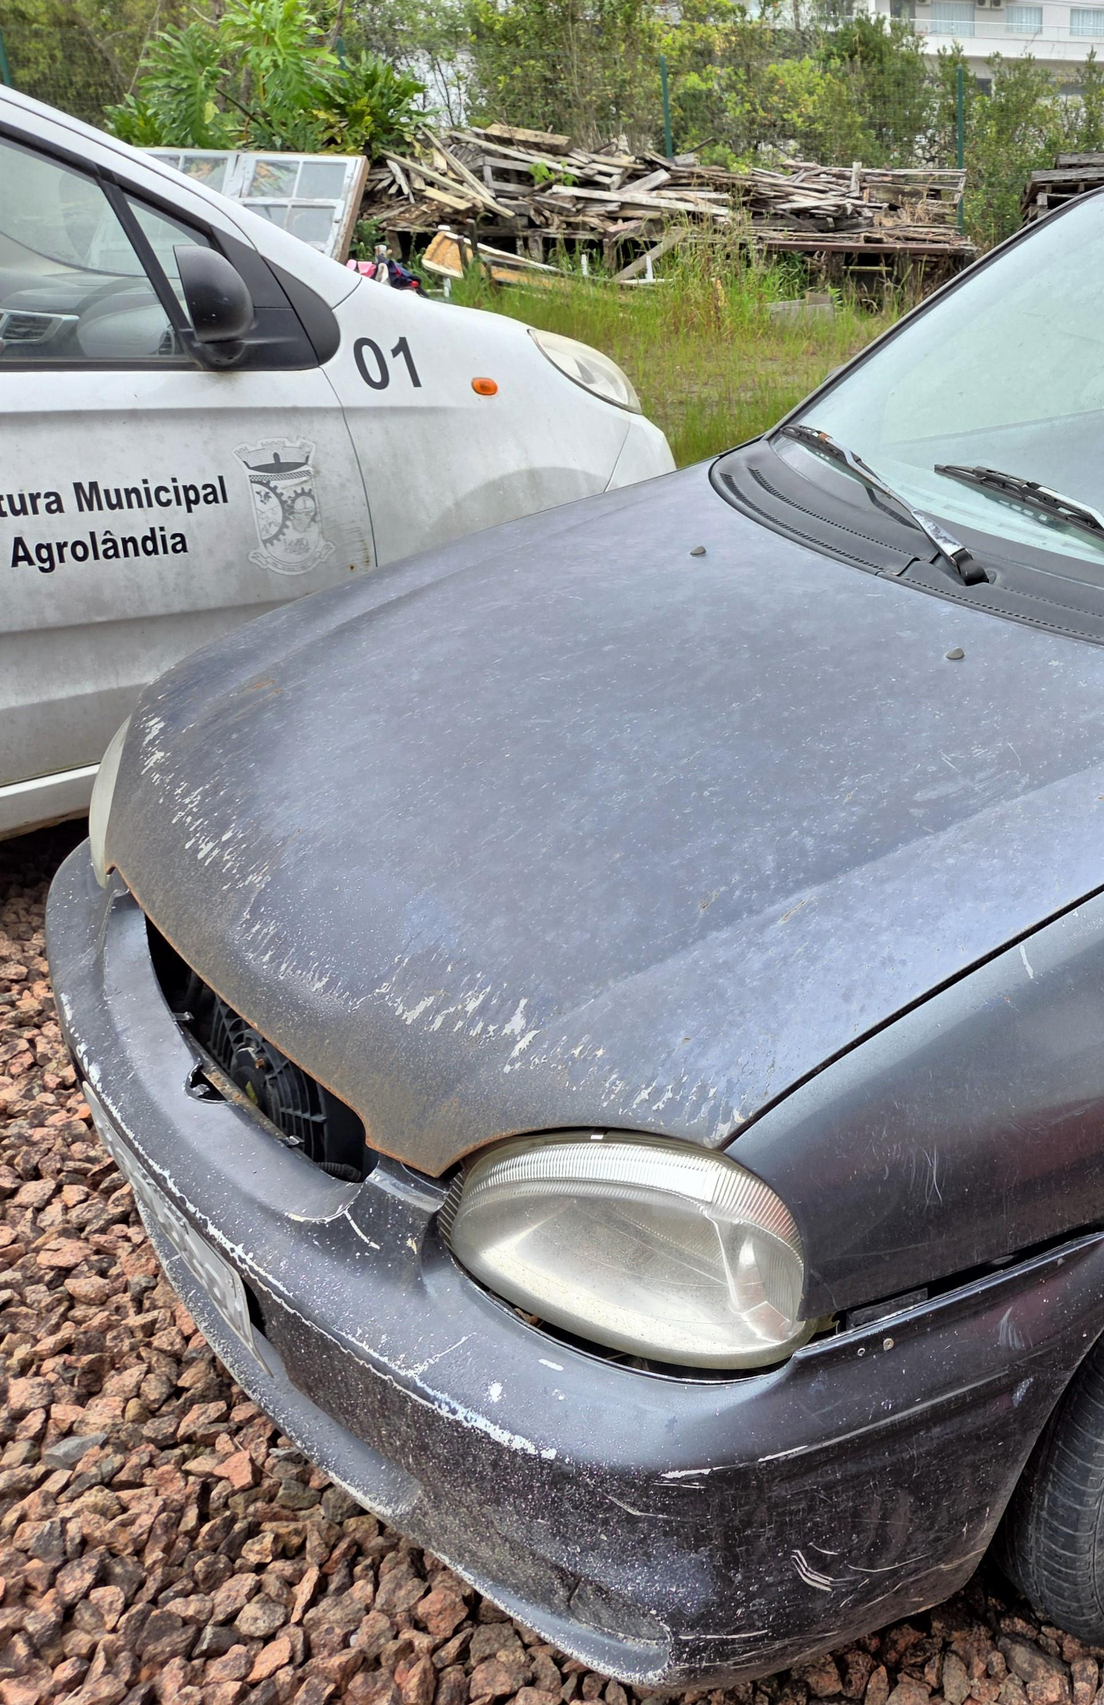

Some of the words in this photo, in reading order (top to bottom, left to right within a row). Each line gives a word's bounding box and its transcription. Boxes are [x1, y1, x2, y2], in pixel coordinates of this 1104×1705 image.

[353, 336, 422, 390] 01
[72, 475, 229, 513] Municipal
[11, 526, 188, 574] Agrolândia
